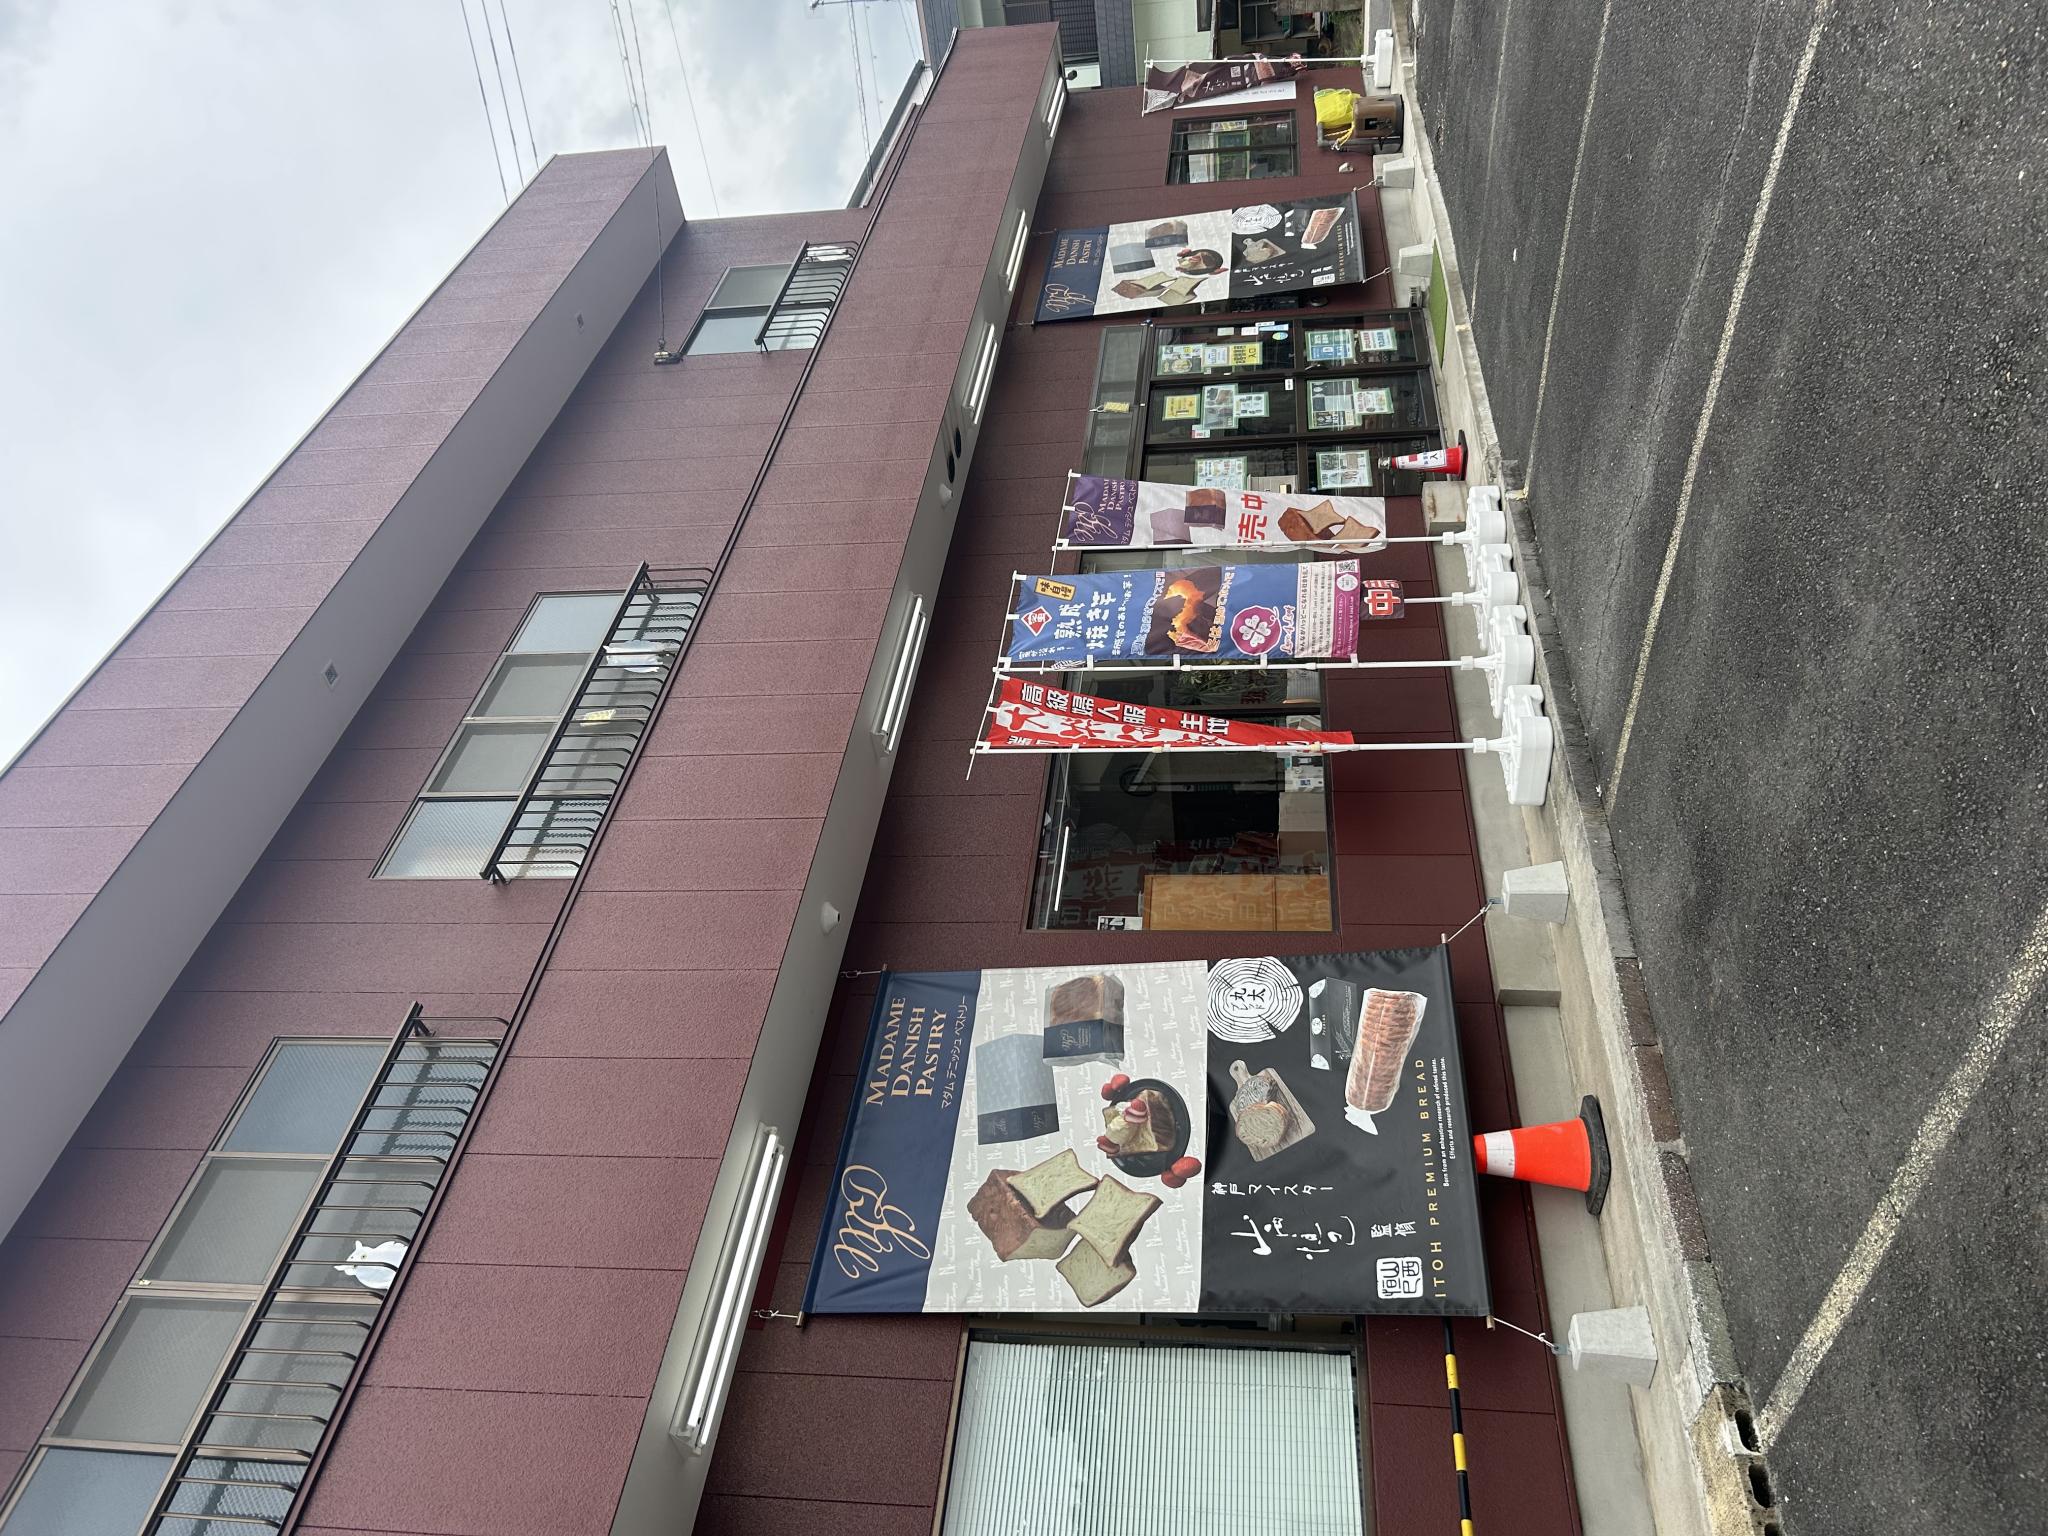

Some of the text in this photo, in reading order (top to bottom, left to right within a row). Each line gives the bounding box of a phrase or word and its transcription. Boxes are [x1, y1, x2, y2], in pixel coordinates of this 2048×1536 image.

[1054, 237, 1069, 268] MADAME
[1066, 239, 1080, 264] DANISH
[1078, 240, 1092, 264] PASTRY
[1040, 582, 1072, 598] 味自慢
[1230, 988, 1266, 1002] 丸太
[864, 998, 906, 1106] MADAME
[890, 1007, 926, 1098] DANISH
[914, 1008, 947, 1097] PASTRY
[946, 1038, 962, 1079] デニッシュ
[941, 1082, 955, 1110] マダム
[1442, 1082, 1451, 1105] produced
[1211, 1182, 1334, 1196] 神戸マイスター
[1414, 1058, 1448, 1298] ITOH PREMIUM BREAD
[1370, 1220, 1418, 1238] 監修
